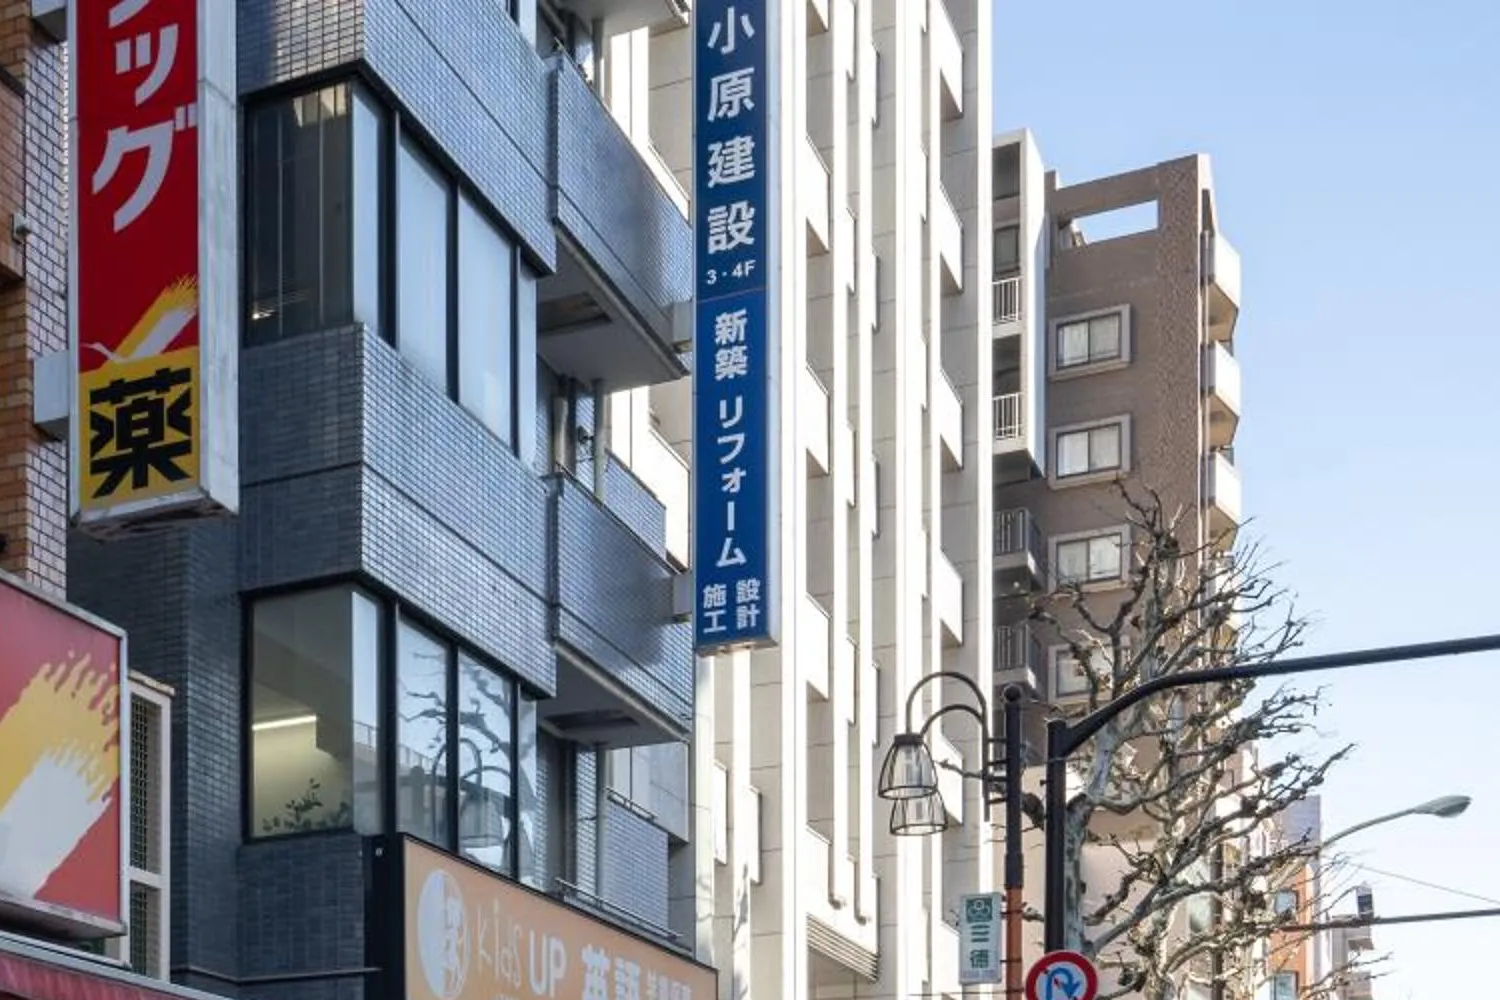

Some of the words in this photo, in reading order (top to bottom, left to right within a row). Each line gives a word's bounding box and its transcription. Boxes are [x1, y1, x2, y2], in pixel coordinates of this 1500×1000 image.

[707, 5, 755, 254] 小原建設
[715, 308, 748, 381] 新築
[89, 367, 192, 500] 薬
[716, 395, 747, 568] リフォーム
[703, 583, 727, 634] 施工
[736, 578, 761, 630] 設計
[528, 928, 568, 999] UP
